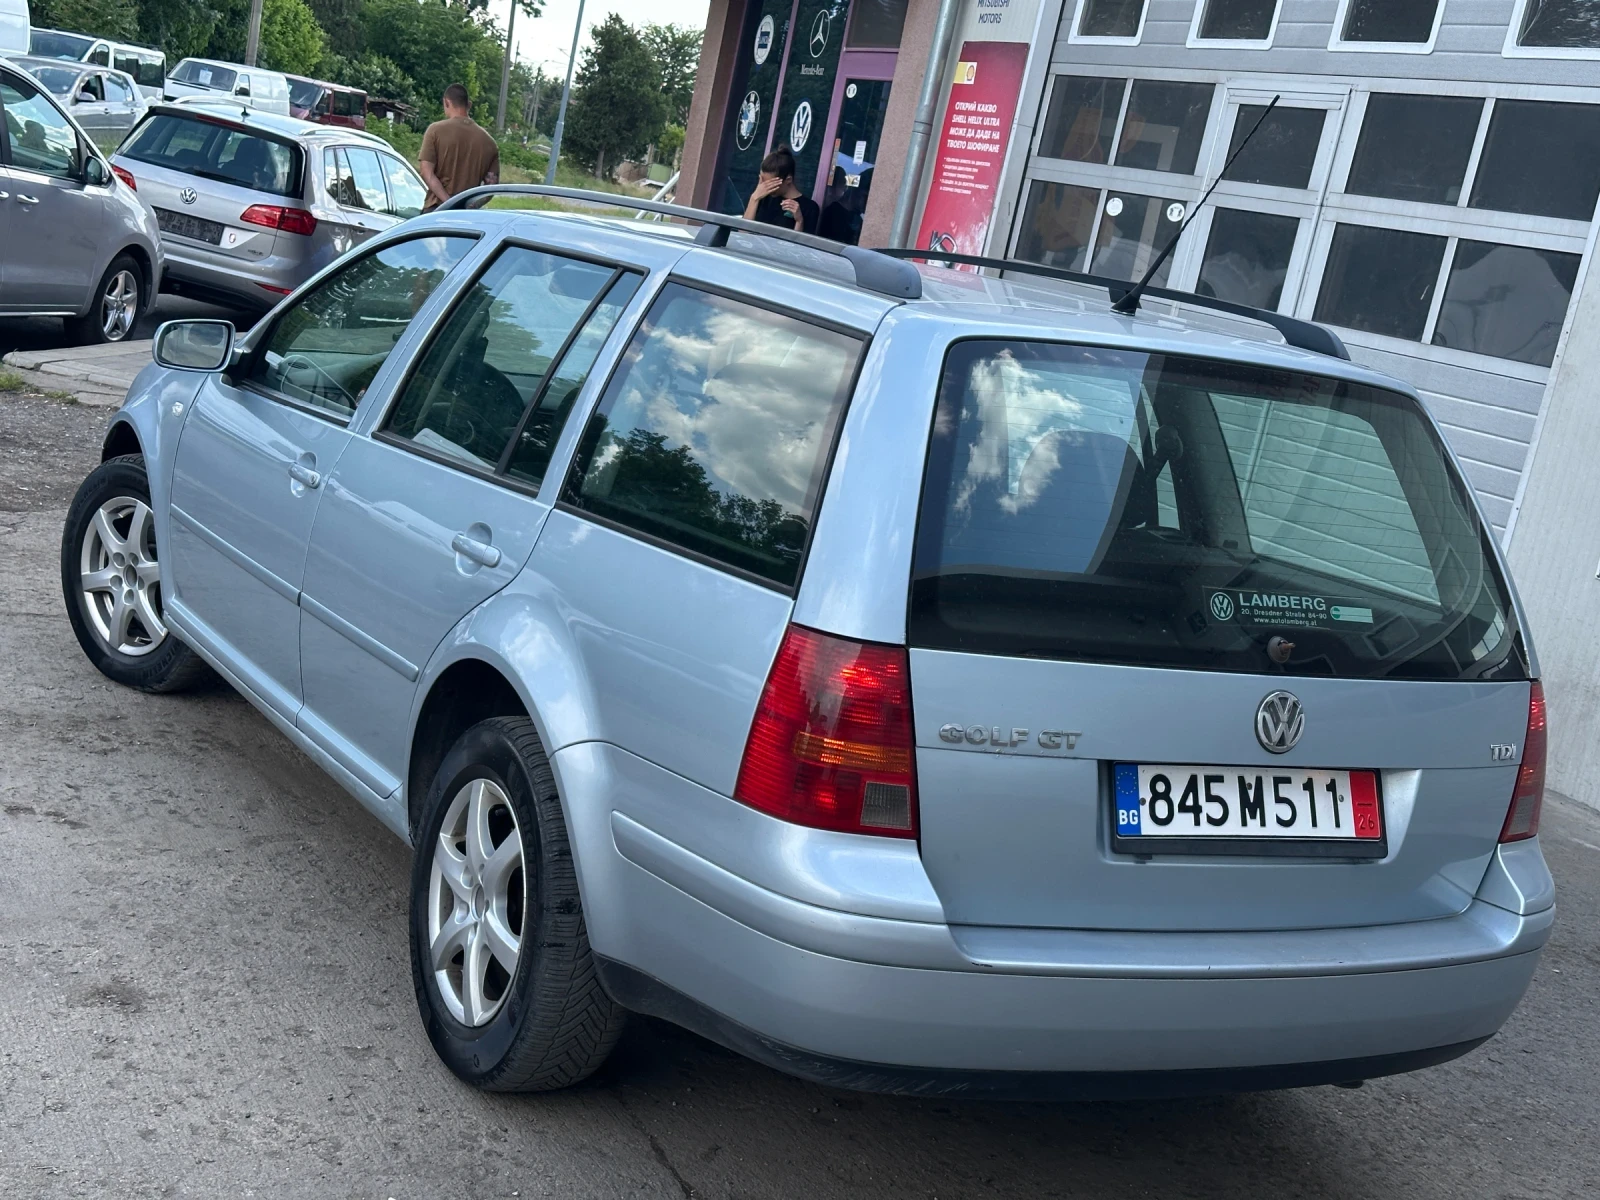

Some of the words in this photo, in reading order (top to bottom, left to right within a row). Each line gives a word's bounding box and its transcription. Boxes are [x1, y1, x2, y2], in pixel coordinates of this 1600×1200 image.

[978, 13, 1002, 24] MOTORS
[955, 101, 977, 111] ОТКРИЙ
[977, 103, 998, 113] КАКВО
[952, 114, 967, 124] SHELL
[967, 115, 983, 125] HELIX
[983, 117, 1000, 127] ULTRA
[949, 127, 967, 136] МОЖЕ
[966, 128, 975, 138] ДА
[975, 129, 992, 139] ДАДЕ
[992, 131, 1000, 140] НА
[967, 141, 1000, 153] ШОФИРАНЕ
[1239, 593, 1327, 611] LAMBERG
[1254, 609, 1283, 617] Dresdner
[1308, 612, 1328, 620] 84-90
[1254, 617, 1318, 627] www.autolamberg.at
[939, 723, 1029, 748] GOLF
[1037, 729, 1083, 750] GT
[1490, 743, 1517, 761] TDI
[1118, 809, 1139, 826] BG
[1357, 813, 1375, 831] 26
